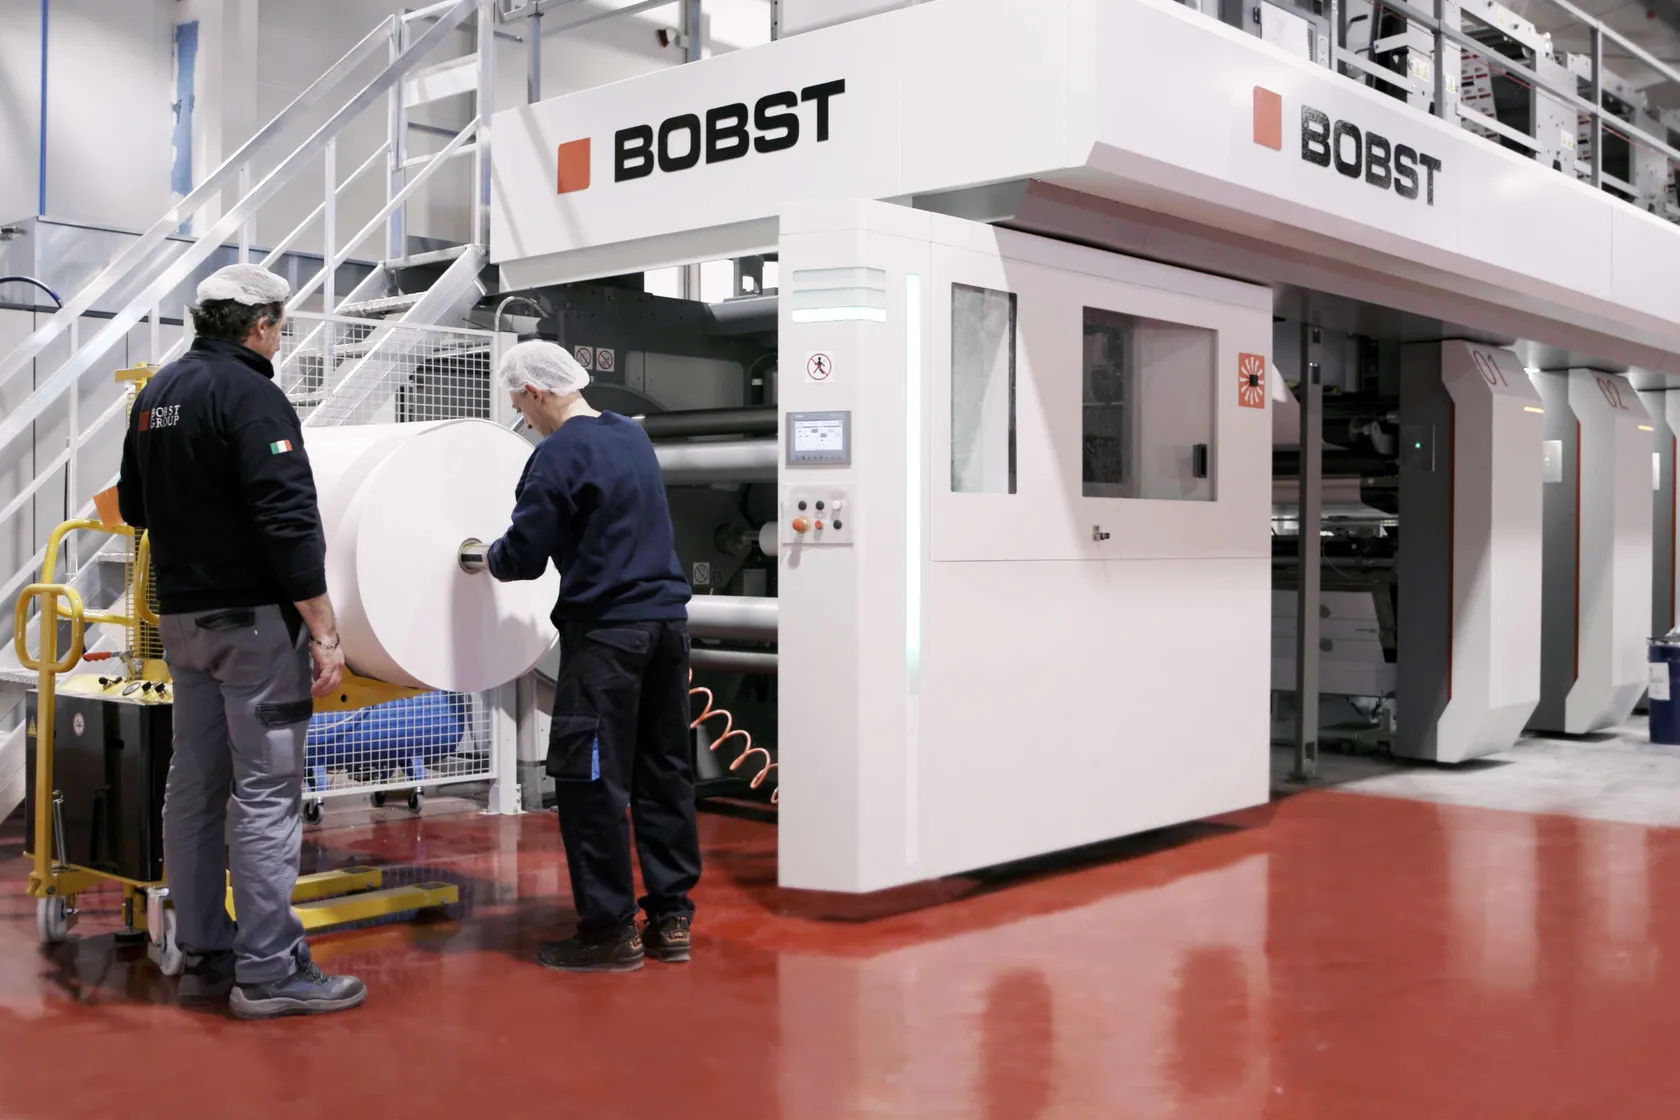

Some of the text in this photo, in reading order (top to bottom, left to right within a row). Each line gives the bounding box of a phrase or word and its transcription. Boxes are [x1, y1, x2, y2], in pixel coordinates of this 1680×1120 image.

[615, 78, 845, 182] BOBST
[1301, 104, 1441, 206] BOBST
[1473, 350, 1508, 387] 01
[1597, 377, 1628, 410] 02
[150, 415, 180, 429] GROUP
